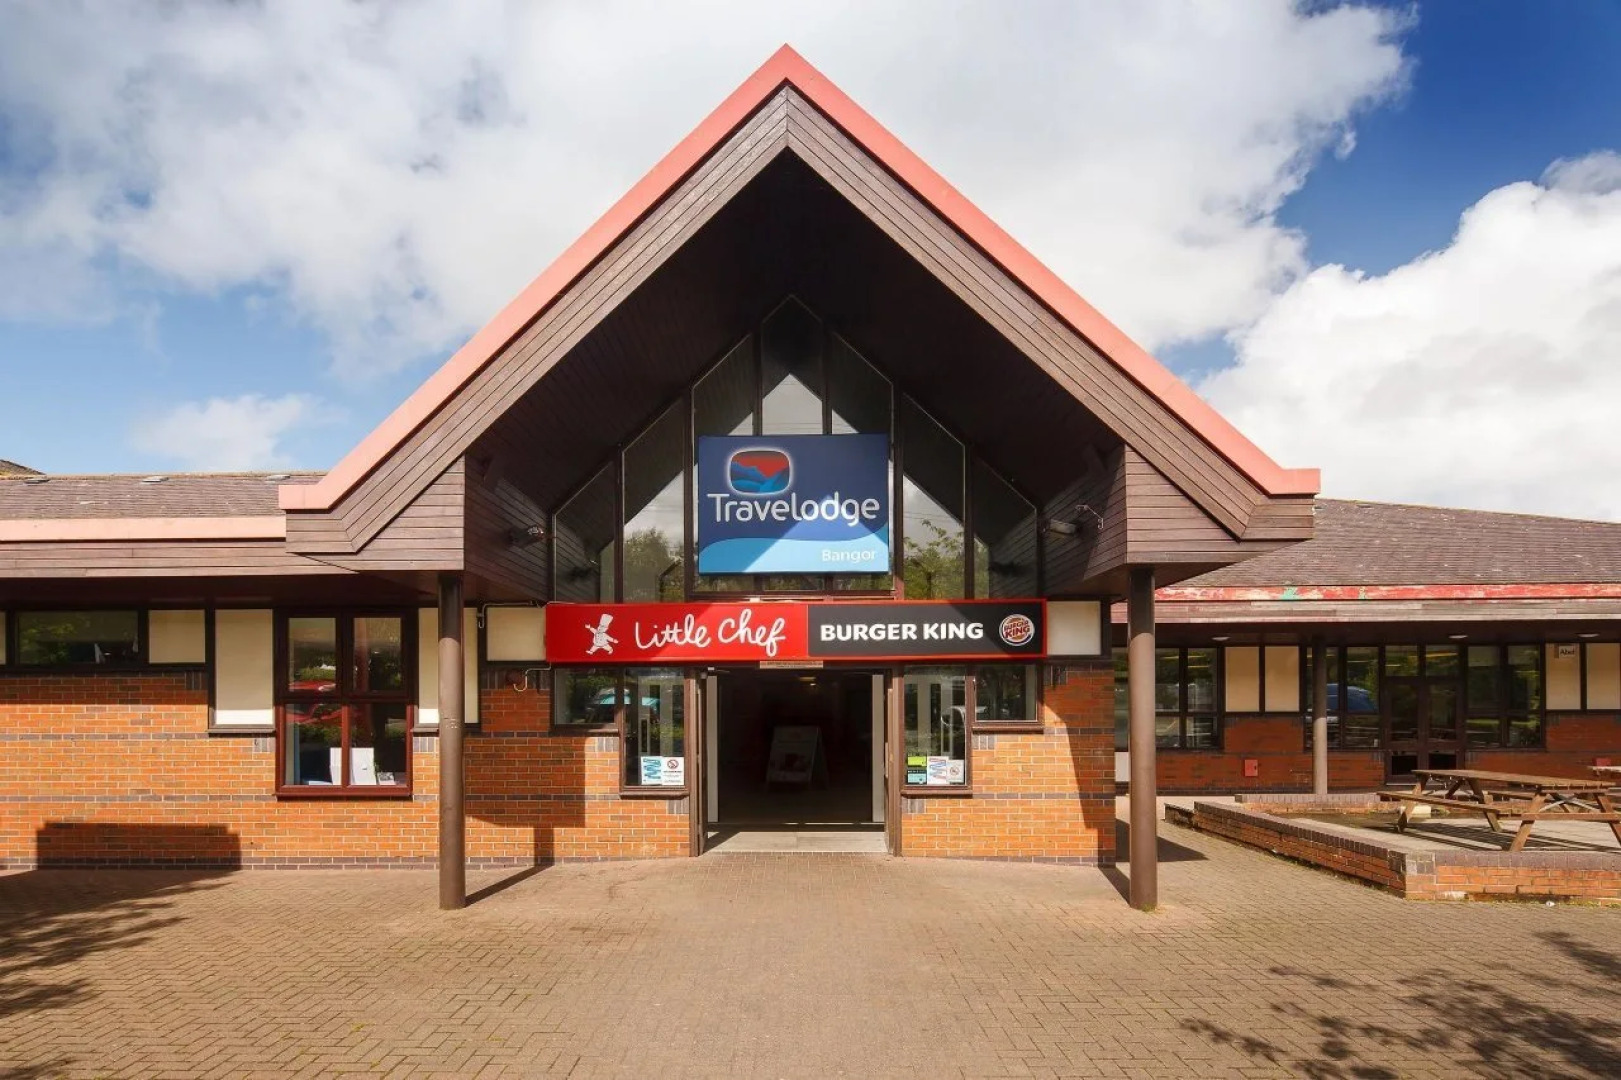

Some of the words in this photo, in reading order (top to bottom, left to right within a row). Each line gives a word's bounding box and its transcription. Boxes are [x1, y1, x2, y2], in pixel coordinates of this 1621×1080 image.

[707, 491, 880, 527] Travelodge
[821, 550, 876, 564] Bangor
[634, 613, 712, 649] Little
[717, 608, 786, 657] Chef
[820, 623, 918, 642] BURGER
[922, 622, 985, 641] KING
[1005, 626, 1031, 639] KING
